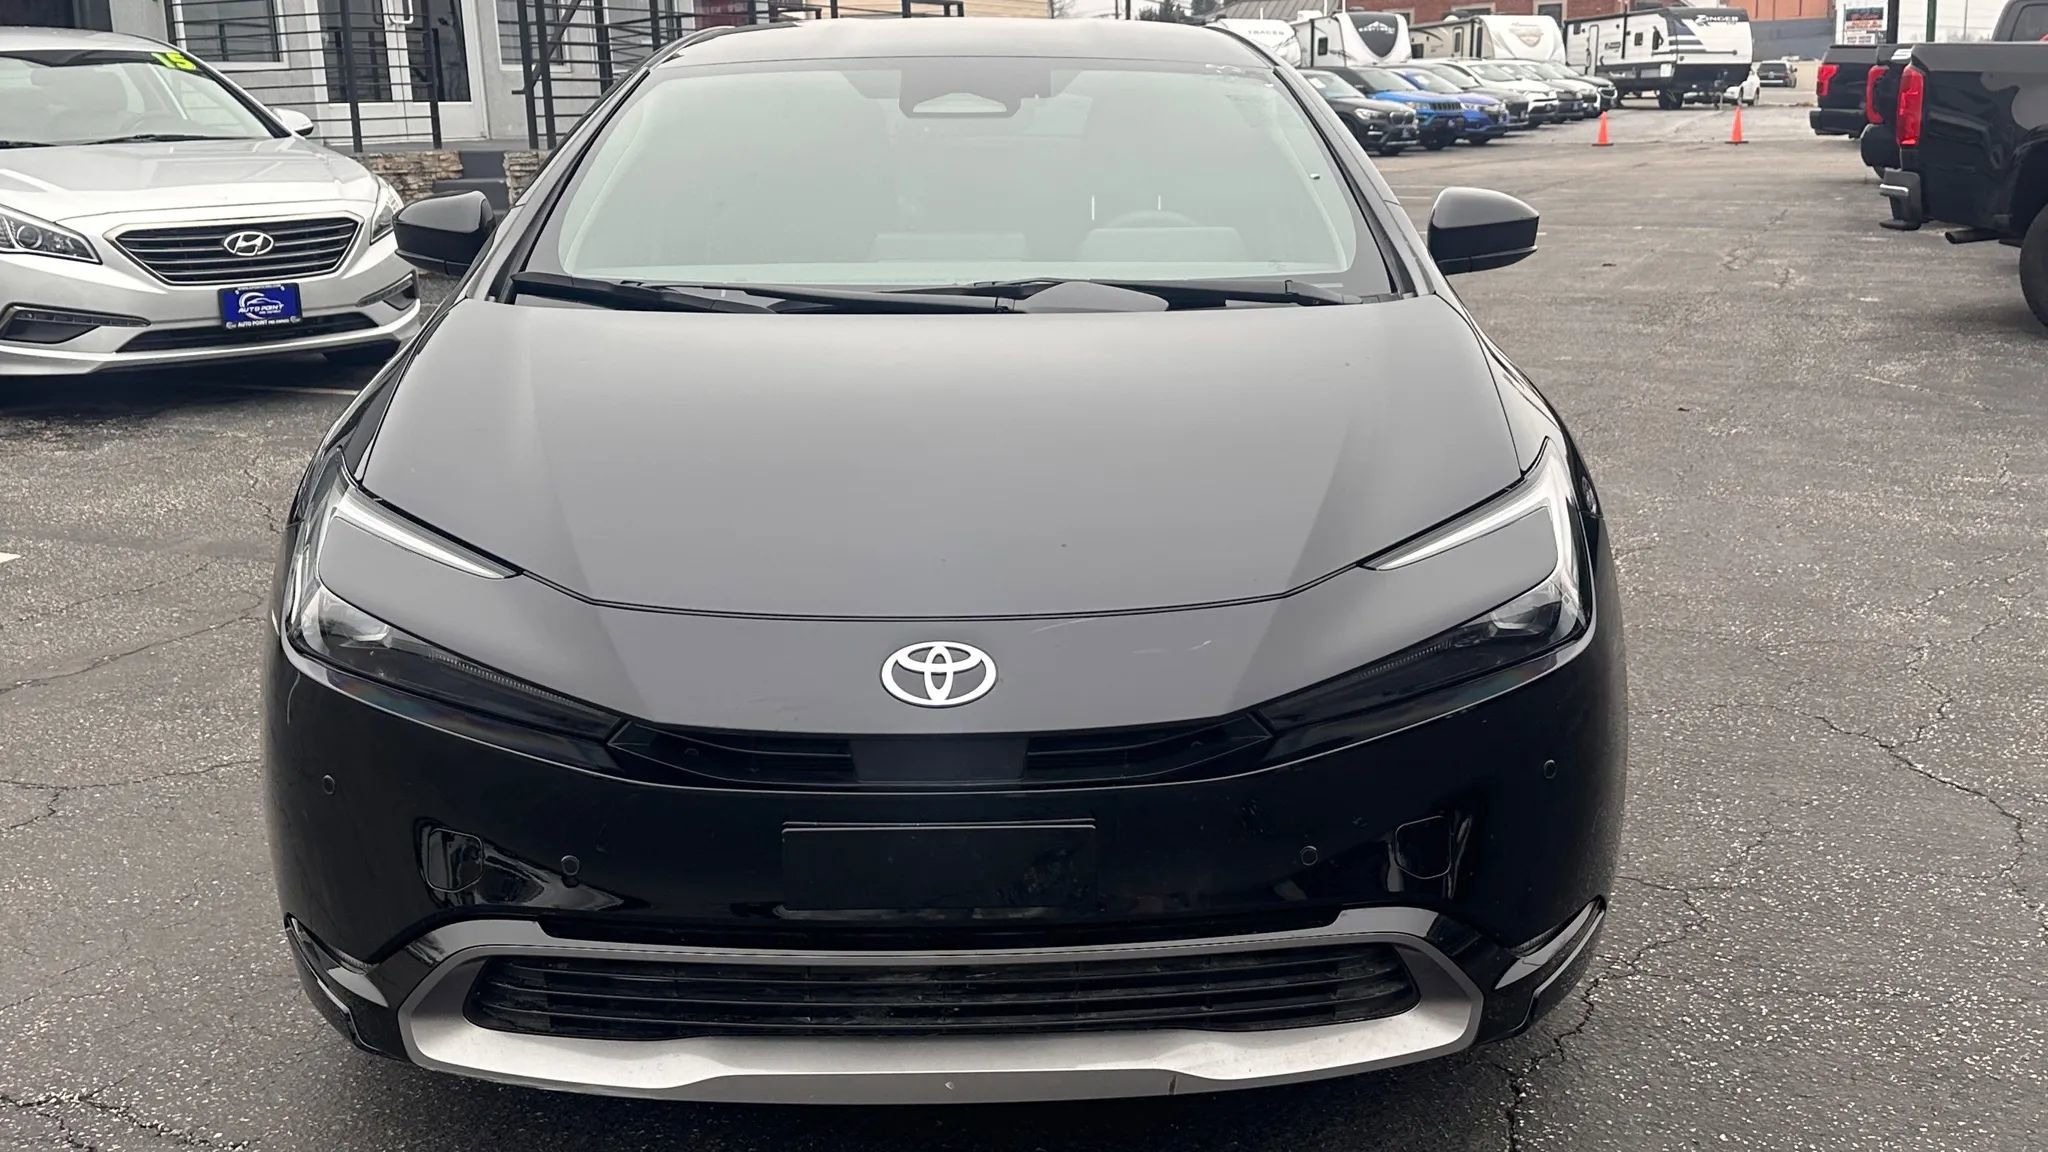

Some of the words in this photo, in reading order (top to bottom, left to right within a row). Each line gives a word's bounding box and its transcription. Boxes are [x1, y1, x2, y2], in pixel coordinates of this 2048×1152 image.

[151, 51, 197, 70] 15
[238, 305, 260, 314] AUTO
[260, 303, 285, 311] POINT
